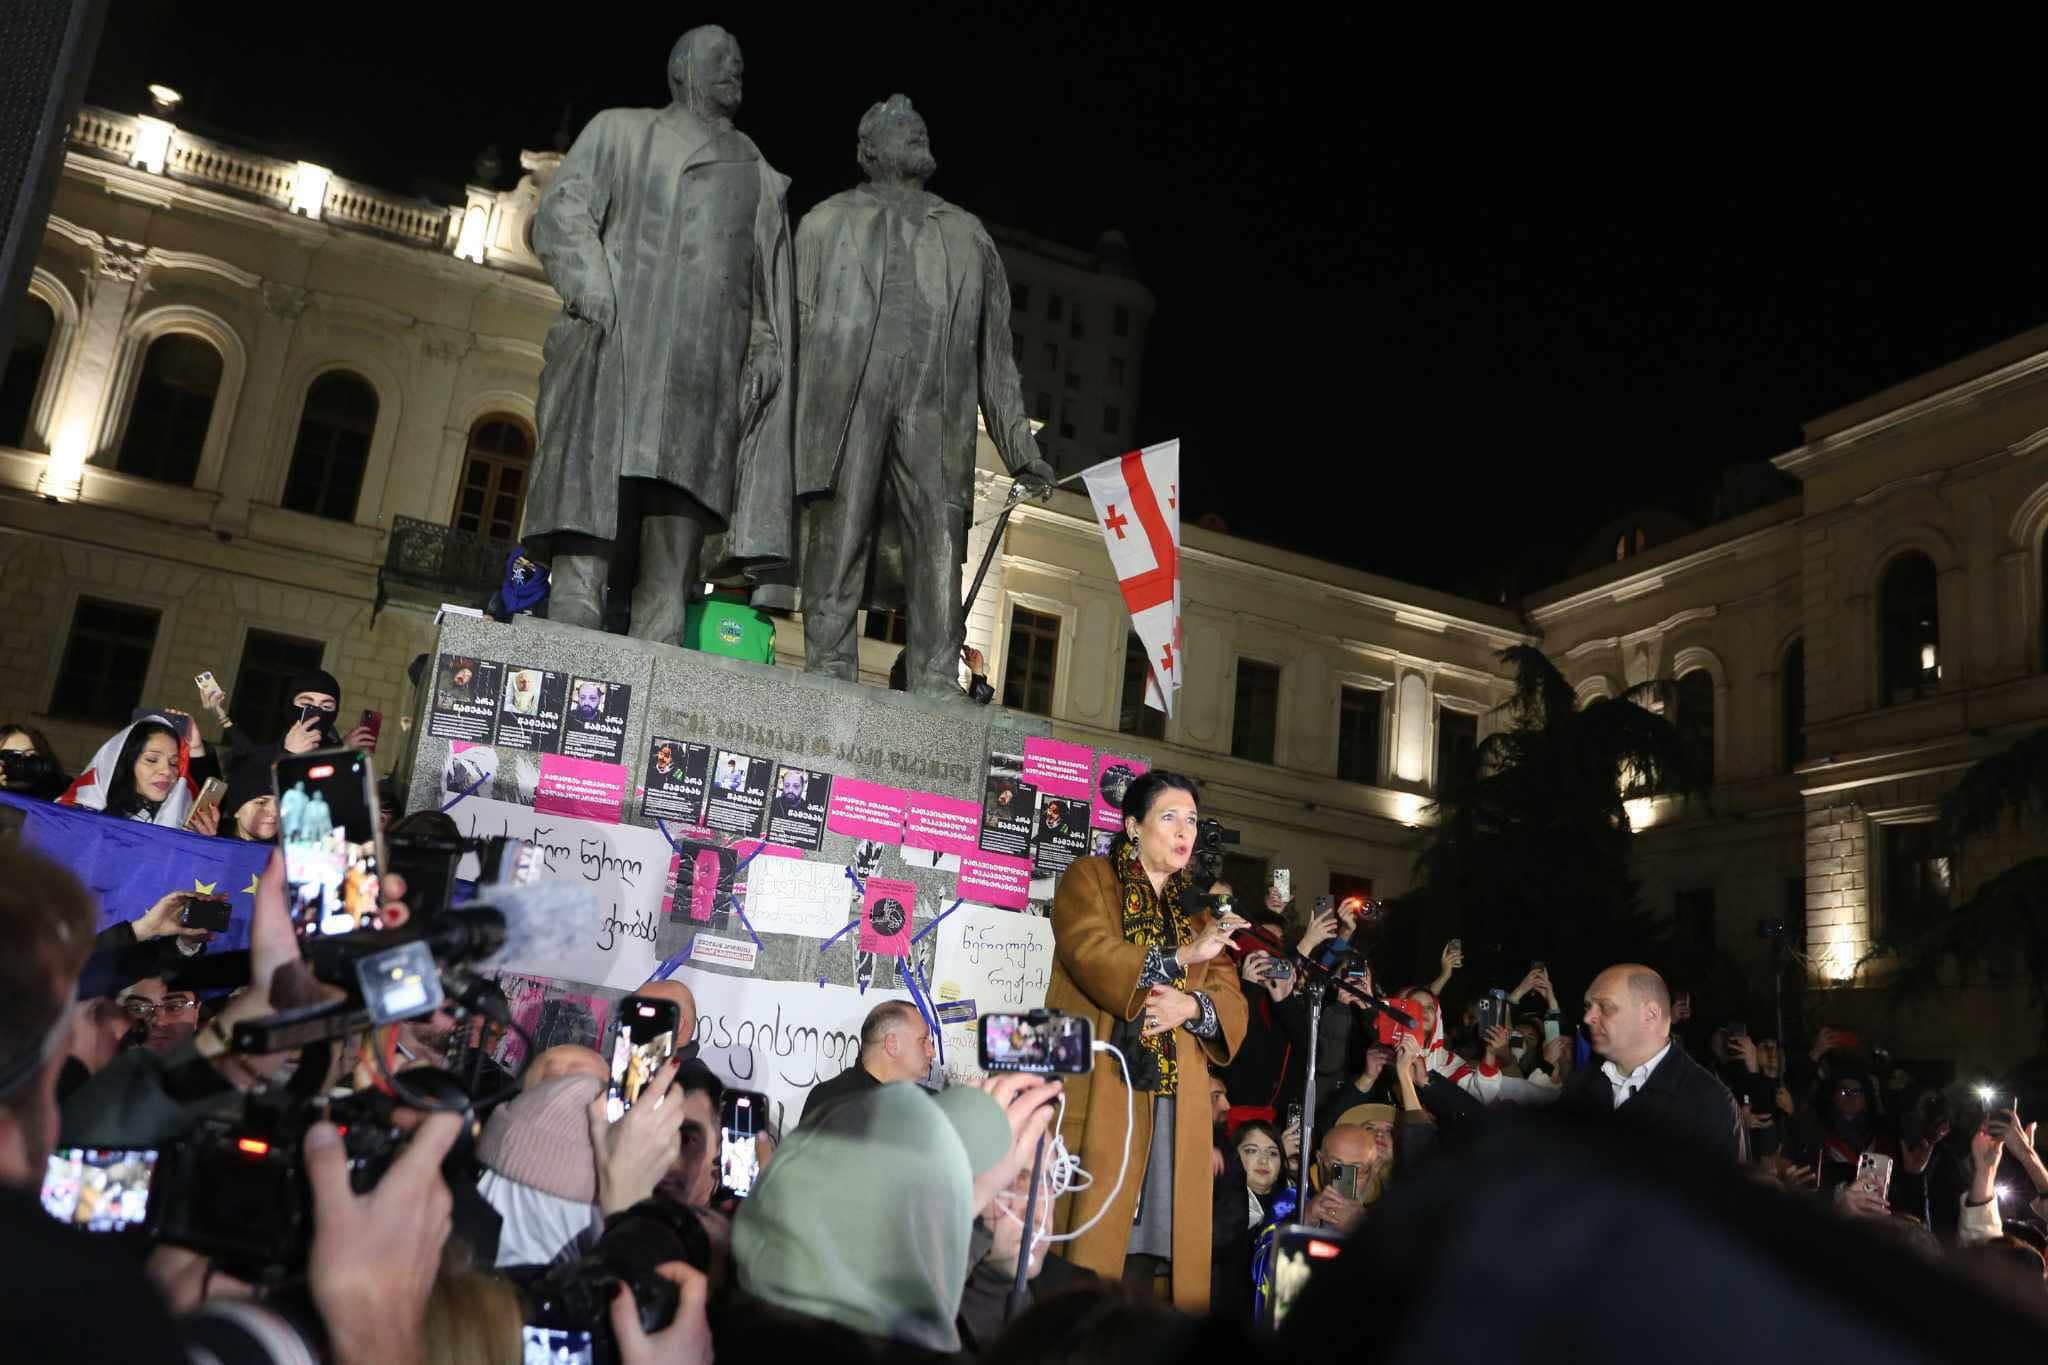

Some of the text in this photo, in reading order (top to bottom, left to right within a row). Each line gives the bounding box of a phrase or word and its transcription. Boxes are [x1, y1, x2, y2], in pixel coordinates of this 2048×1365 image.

[684, 776, 702, 786] არა
[1015, 815, 1031, 825] არა
[1069, 831, 1085, 840] არა
[581, 839, 642, 888] წერილი
[596, 903, 657, 951] ვრობას
[962, 924, 1043, 968] წერილები
